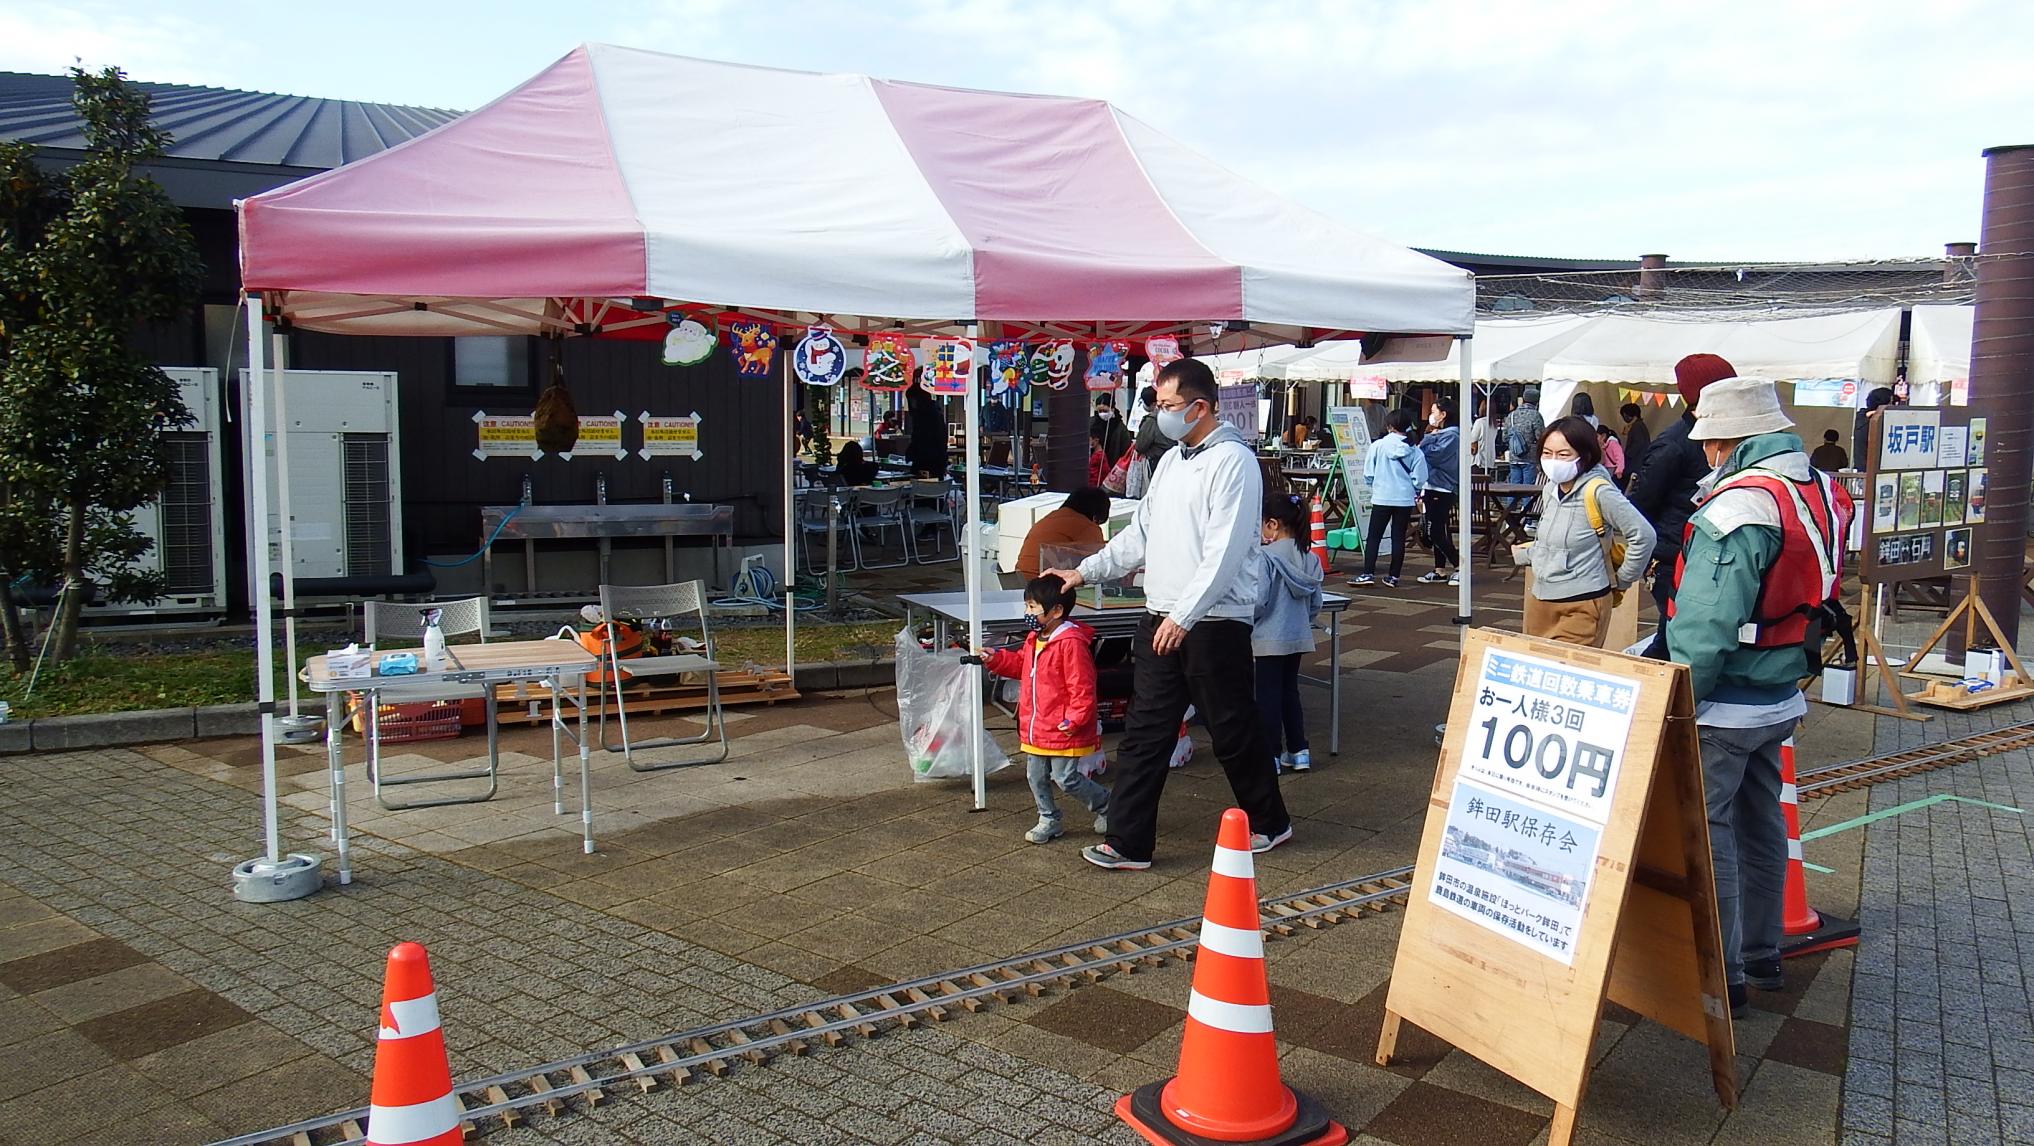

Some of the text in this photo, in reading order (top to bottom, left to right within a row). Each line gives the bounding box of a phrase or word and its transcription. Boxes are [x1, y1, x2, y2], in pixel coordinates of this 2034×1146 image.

[1887, 424, 1935, 454] 坂戸駅
[1479, 685, 1586, 733] お一人様3回
[1486, 656, 1632, 711] ミニ鉄道回数乗車券
[1480, 716, 1615, 799] 100円
[1466, 796, 1578, 854] 鉾田駅保存会
